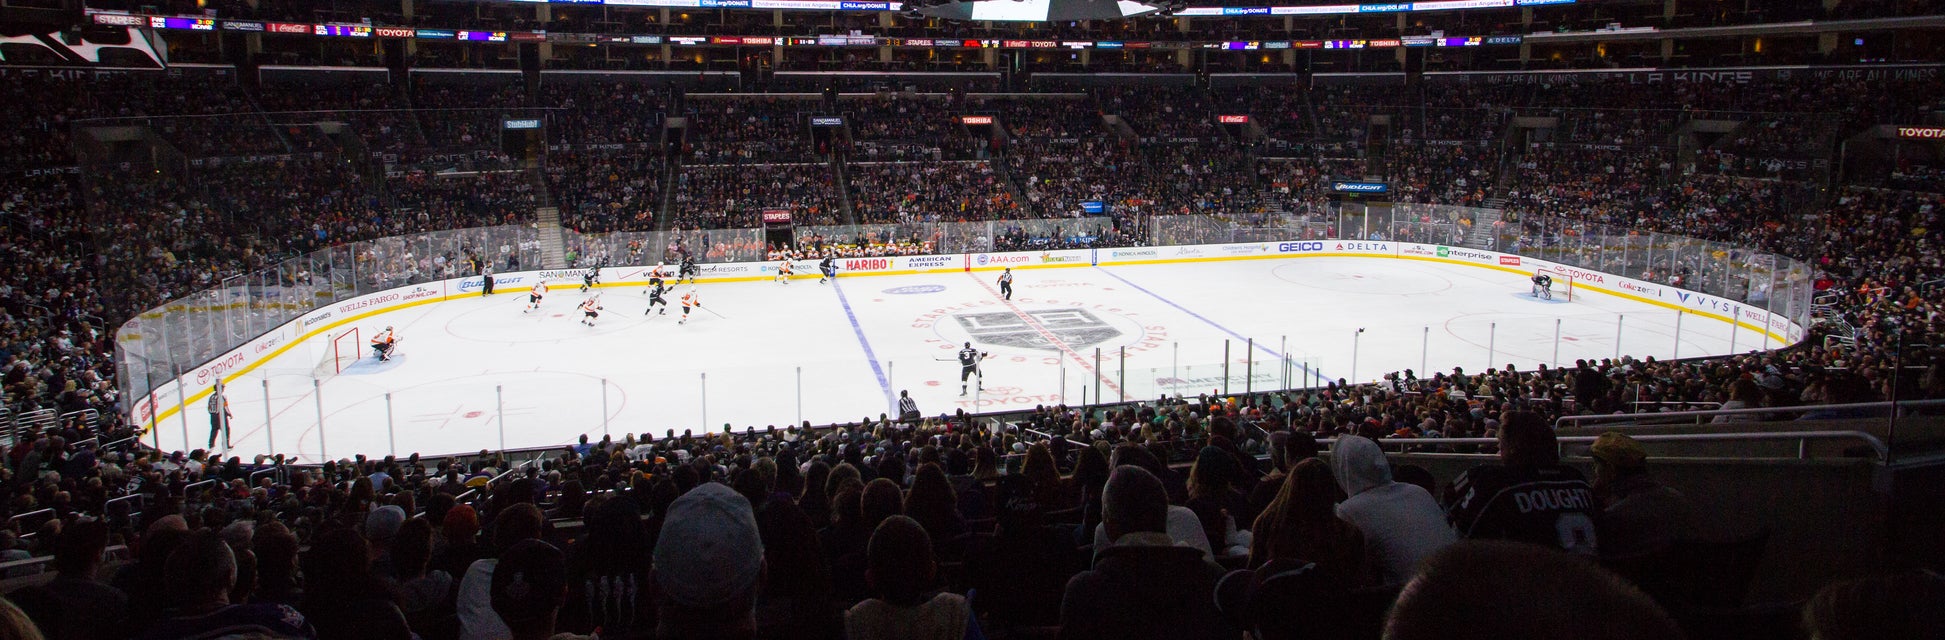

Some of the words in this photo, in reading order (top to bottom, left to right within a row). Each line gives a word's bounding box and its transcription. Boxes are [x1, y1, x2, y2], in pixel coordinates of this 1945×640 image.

[99, 16, 142, 25] STAPLES
[377, 29, 415, 37] TOYOTA
[764, 212, 790, 220] STAPLES
[1279, 242, 1322, 252] GEICO
[847, 259, 887, 270] HARIBO
[990, 255, 1029, 264] AAA.com
[1568, 270, 1604, 283] TOYOTA
[1618, 281, 1636, 291] Coke
[339, 298, 368, 313] WELLS
[370, 293, 400, 307] FARGO
[1746, 310, 1767, 324] WELL
[211, 352, 245, 377] TOYOTA
[954, 393, 1068, 408] TOYOTA
